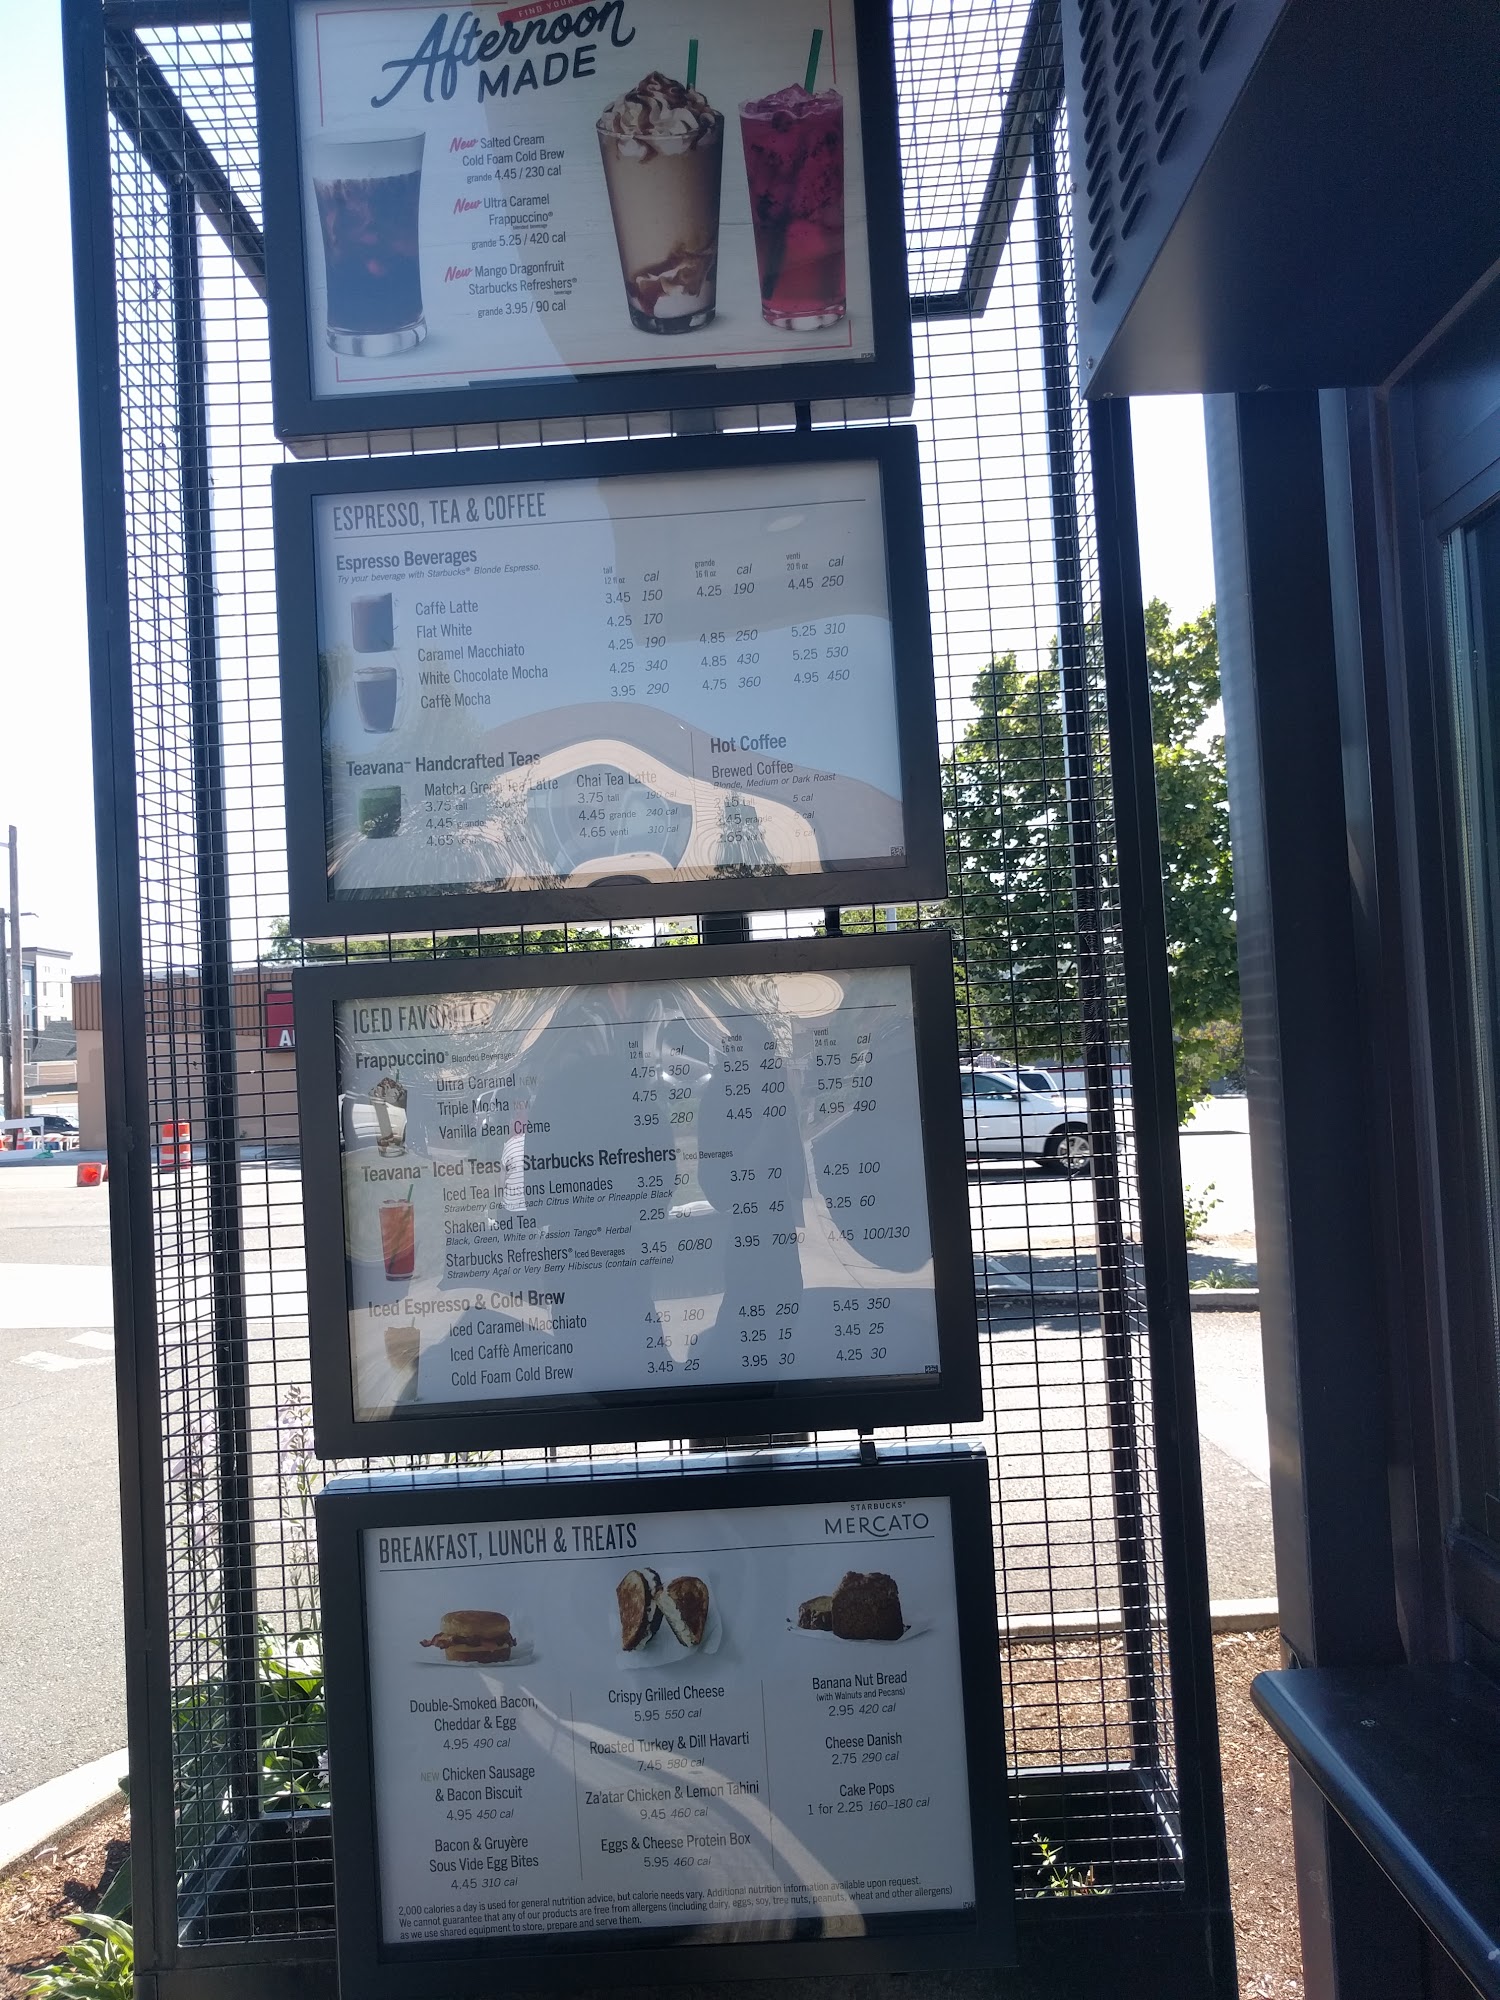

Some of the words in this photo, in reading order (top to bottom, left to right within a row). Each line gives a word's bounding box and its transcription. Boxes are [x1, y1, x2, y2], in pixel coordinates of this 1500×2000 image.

[518, 5, 542, 18] FIND
[371, 0, 635, 108] Afternoon
[477, 44, 597, 103] MADE
[450, 137, 478, 153] New
[480, 137, 510, 148] Salted
[513, 135, 544, 146] Cream
[463, 156, 483, 166] Cold
[487, 153, 513, 164] Foam
[516, 151, 537, 162] Cold
[540, 150, 564, 160] Brew
[467, 173, 492, 184] grande
[495, 168, 517, 180] 4.45
[526, 167, 544, 178] 230
[548, 165, 561, 176] cal
[454, 198, 482, 214] New
[484, 197, 507, 208] Ultra
[510, 194, 550, 206] Caramel
[472, 239, 496, 250] grande
[500, 234, 521, 246] 5.25
[530, 233, 549, 244] 420
[552, 231, 565, 243] cal
[445, 266, 473, 282] New
[475, 265, 507, 278] Mango
[510, 261, 564, 276] Dragonfruit
[469, 282, 517, 295] Starbucks
[478, 307, 503, 318] grande
[506, 302, 527, 314] 3.95
[536, 301, 549, 312] 90
[552, 299, 566, 311] cal
[333, 502, 424, 531] ESPRESSO,
[429, 499, 460, 524] TEA
[466, 498, 479, 522] &
[485, 492, 546, 520] COFFEE
[337, 554, 399, 573] Espresso
[404, 550, 477, 567] Beverages
[338, 575, 349, 584] Try
[351, 574, 367, 584] your
[371, 572, 405, 582] beverage
[408, 570, 424, 579] with
[474, 566, 501, 574] Blonde
[605, 592, 631, 604] 3.45
[642, 589, 663, 602] 150
[697, 585, 722, 597] 4.25
[733, 583, 755, 595] 190
[788, 578, 814, 590] 4.45
[821, 575, 844, 587] 250
[416, 602, 446, 615] Caffè
[450, 600, 478, 614] Latte
[417, 626, 437, 638] Flat
[440, 624, 472, 637] White
[608, 638, 633, 650] 4.25
[645, 636, 666, 649] 190
[700, 632, 725, 644] 4.85
[735, 629, 758, 642] 250
[791, 625, 816, 637] 5.25
[824, 622, 846, 635] 310
[418, 647, 464, 661] Caramel
[468, 644, 525, 659] Macchiato
[419, 671, 450, 685] White
[453, 668, 508, 683] Chocolate
[512, 665, 548, 680] Mocha
[420, 694, 451, 708] Caffè
[454, 692, 491, 706] Mocha
[711, 736, 736, 754] Hot
[741, 735, 787, 751] Coffee
[712, 764, 753, 778] Brewed
[757, 761, 793, 776] Coffee
[353, 1007, 392, 1034] ICED
[632, 1090, 657, 1102] 4.75
[668, 1088, 691, 1100] 320
[725, 1084, 750, 1096] 5.25
[761, 1081, 785, 1093] 400
[818, 1078, 843, 1090] 5.75
[851, 1076, 872, 1088] 510
[438, 1101, 468, 1117] Triple
[472, 1099, 509, 1114] Mocha
[633, 1114, 659, 1126] 3.95
[670, 1111, 693, 1124] 280
[726, 1107, 752, 1120] 4.45
[763, 1106, 786, 1117] 400
[819, 1102, 845, 1114] 4.95
[853, 1100, 876, 1112] 490
[439, 1124, 477, 1140] Vanilla
[482, 1122, 510, 1136] Bean
[514, 1120, 550, 1134] Crème
[549, 1178, 613, 1194] Lemonades
[446, 1252, 503, 1267] Starbucks
[575, 1250, 589, 1258] Iced
[591, 1248, 625, 1258] Beverages
[451, 1348, 474, 1361] Iced
[478, 1344, 510, 1360] Caffè
[513, 1341, 573, 1357] Americano
[451, 1372, 476, 1386] Cold
[481, 1370, 511, 1384] Foam
[515, 1367, 540, 1382] Cold
[545, 1365, 573, 1380] Brew
[825, 1513, 929, 1537] MERCATO
[379, 1532, 483, 1564] BREAKFAST,
[488, 1527, 547, 1557] LUNCH
[554, 1527, 567, 1553] &
[572, 1522, 637, 1551] TREATS
[812, 1677, 852, 1689] Banana
[855, 1674, 873, 1687] Nut
[877, 1671, 907, 1684] Bread
[608, 1689, 642, 1705] Crispy
[646, 1686, 680, 1702] Grilled
[683, 1685, 725, 1699] Cheese
[817, 1693, 833, 1702] (with
[835, 1691, 862, 1700] Walnuts
[864, 1690, 876, 1698] and
[879, 1687, 905, 1697] Pecans)
[410, 1697, 497, 1713] Double-Smoked
[500, 1696, 538, 1709] Bacon,
[829, 1704, 854, 1716] 2.95
[859, 1703, 879, 1714] 420
[882, 1703, 896, 1712] cal
[434, 1718, 480, 1731] Cheddar
[484, 1717, 492, 1729] &
[496, 1716, 516, 1730] Egg
[634, 1710, 660, 1721] 5.95
[665, 1709, 684, 1719] 550
[688, 1708, 702, 1718] cal
[443, 1738, 468, 1749] 4.95
[473, 1738, 493, 1748] 490
[497, 1738, 511, 1747] cal
[825, 1736, 864, 1749] Cheese
[867, 1732, 902, 1746] Danish
[832, 1753, 857, 1765] 2.75
[862, 1752, 882, 1763] 290
[885, 1751, 899, 1761] cal
[840, 1784, 865, 1797] Cake
[869, 1782, 894, 1796] Pops
[819, 1803, 833, 1814] for
[837, 1802, 863, 1813] 2.25
[916, 1797, 929, 1807] cal
[429, 1859, 456, 1872] Sous
[459, 1857, 483, 1871] Vide
[487, 1856, 507, 1871] Egg
[511, 1855, 539, 1868] Bites
